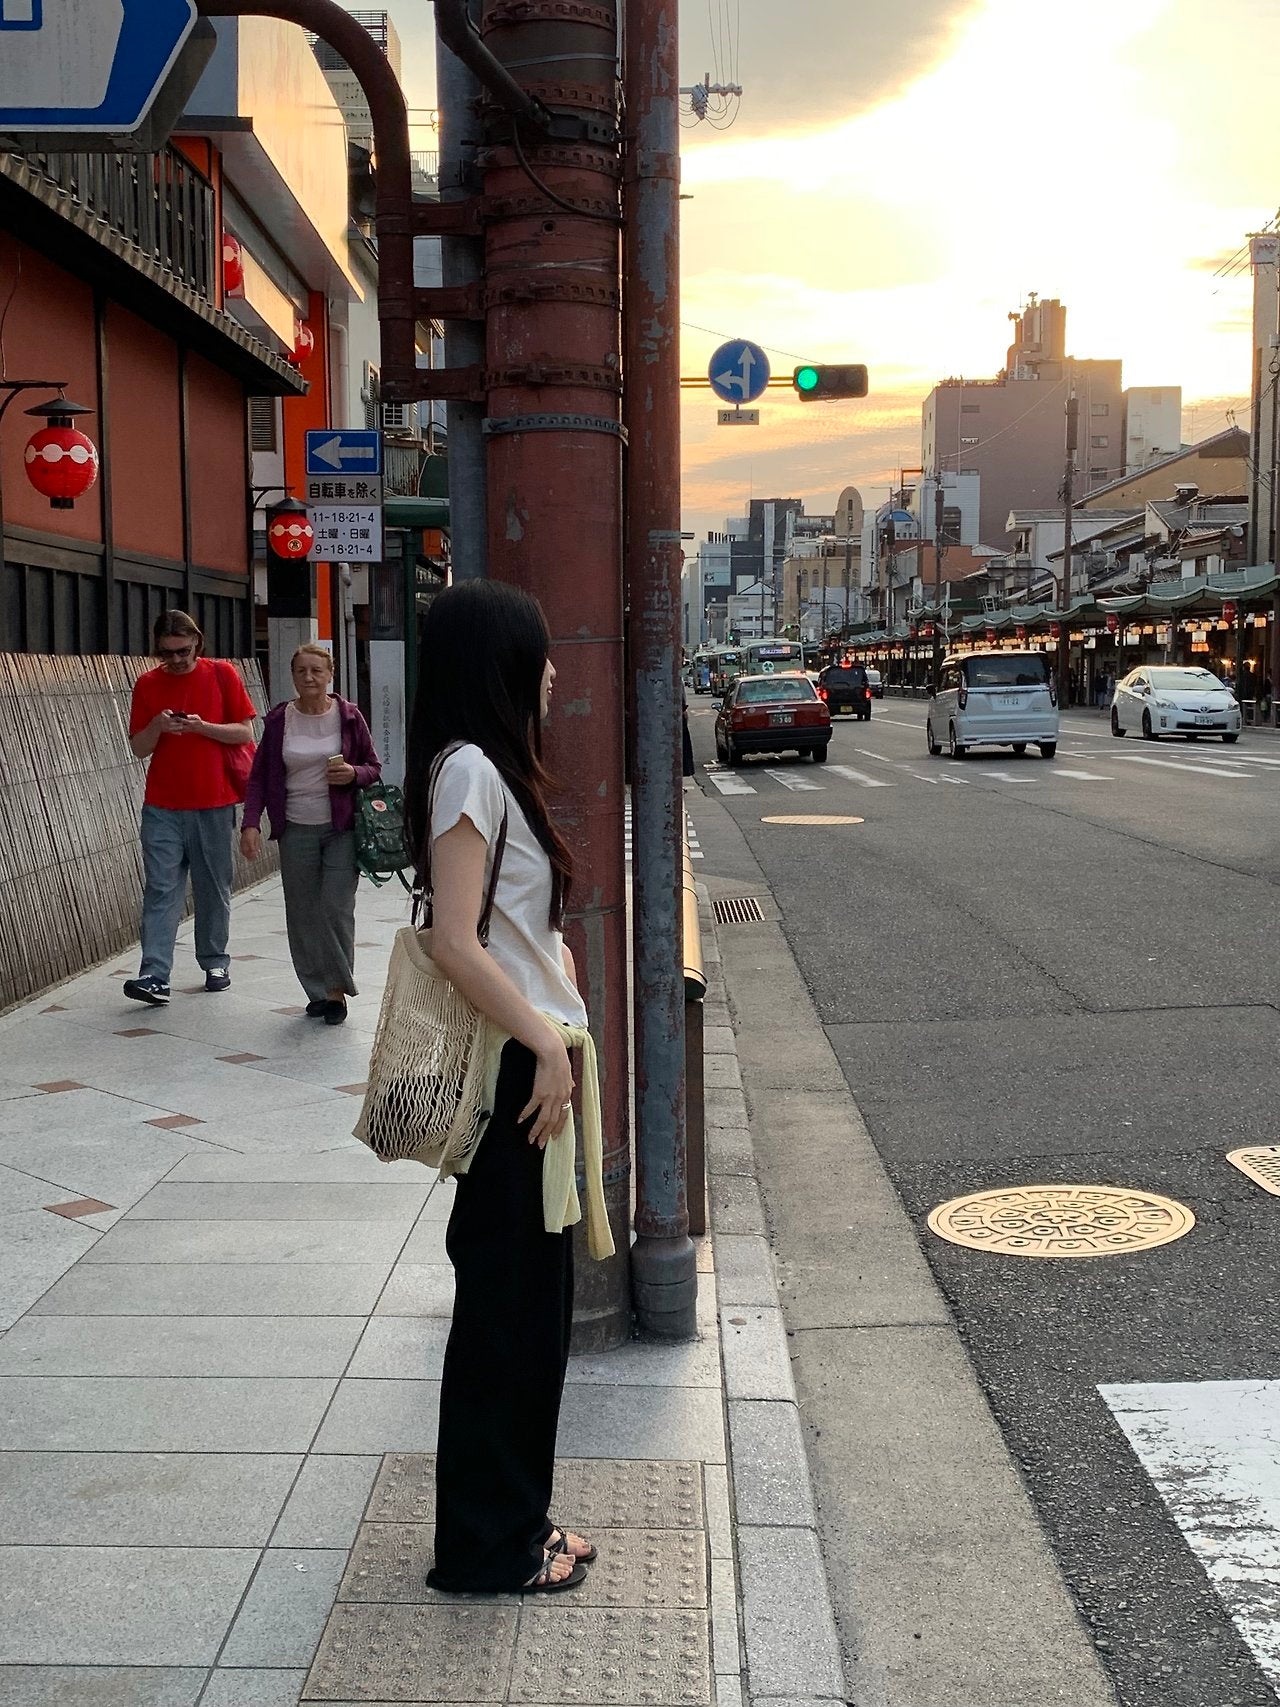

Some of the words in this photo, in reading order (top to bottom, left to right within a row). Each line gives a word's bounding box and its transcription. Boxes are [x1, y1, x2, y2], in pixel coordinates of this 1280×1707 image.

[309, 482, 377, 499] 自転車を除く
